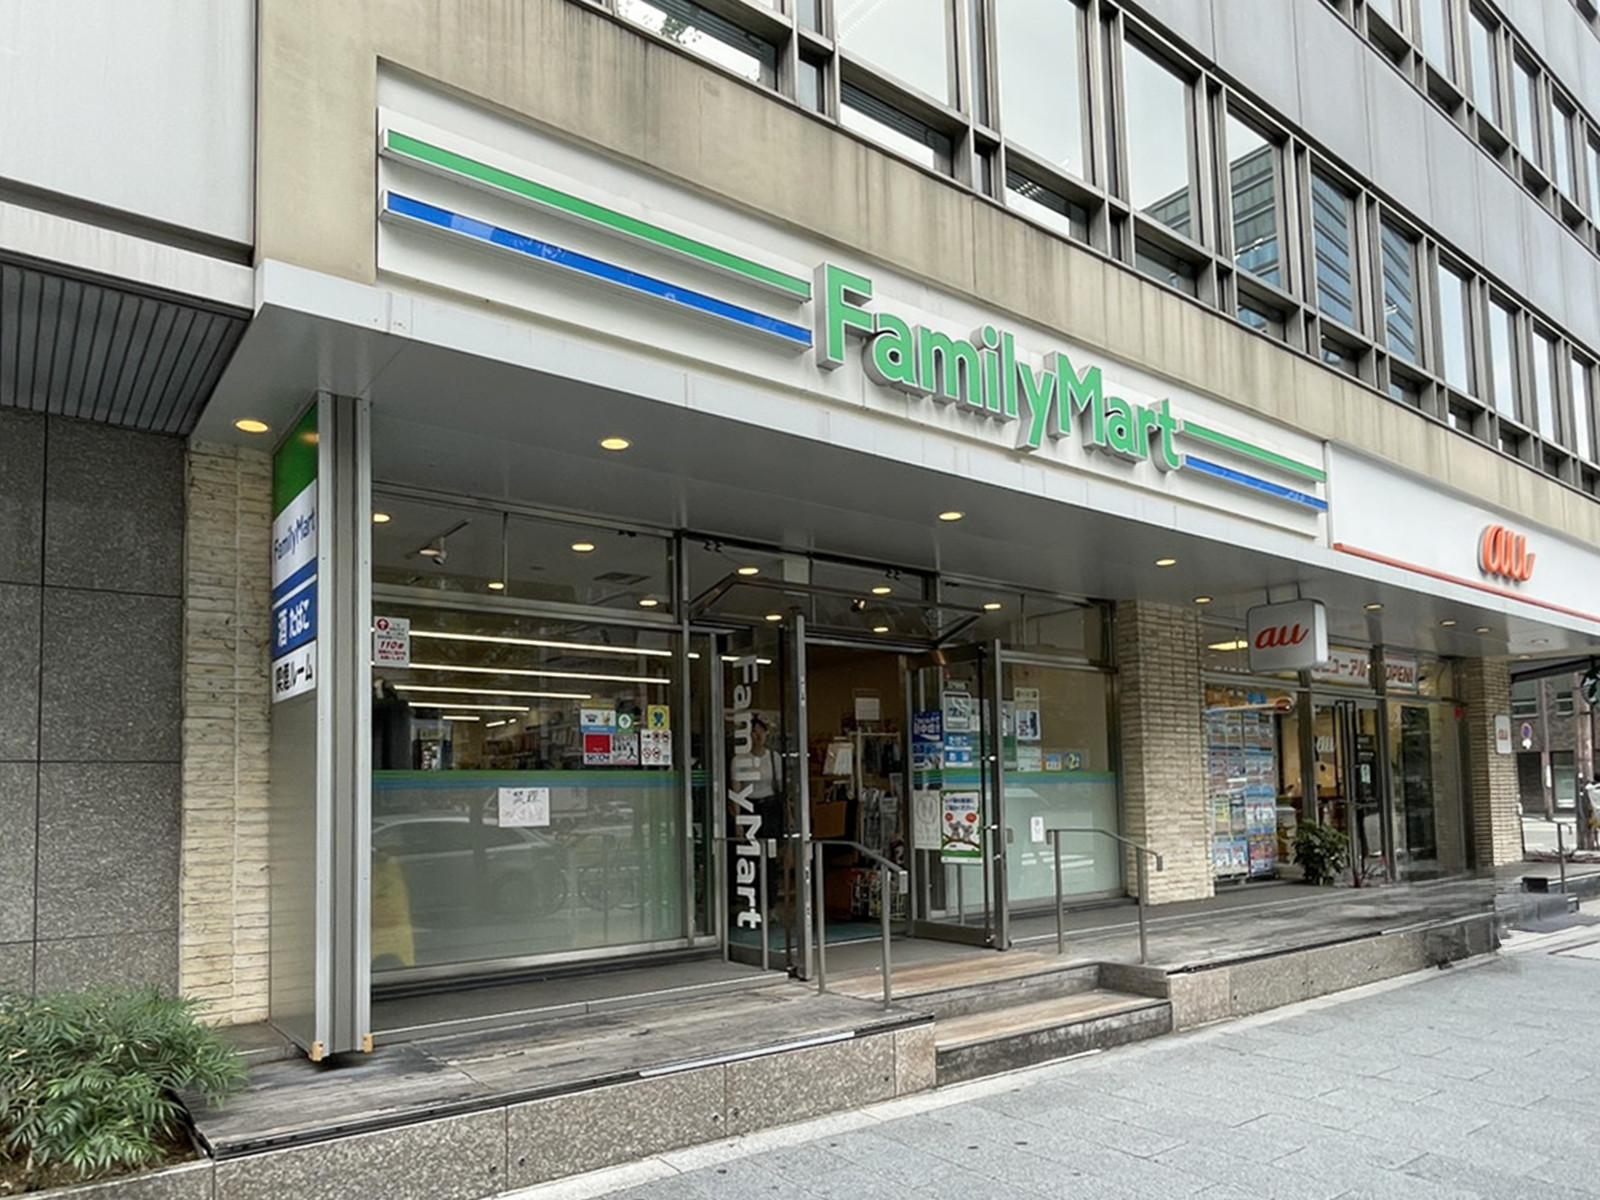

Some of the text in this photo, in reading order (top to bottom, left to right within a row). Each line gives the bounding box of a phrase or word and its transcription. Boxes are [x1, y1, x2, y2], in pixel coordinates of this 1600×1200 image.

[818, 262, 1182, 470] FamilyMart
[274, 506, 316, 562] FamilyMart
[1480, 523, 1536, 582] au
[1254, 623, 1309, 649] au
[728, 655, 762, 930] FamilyMart
